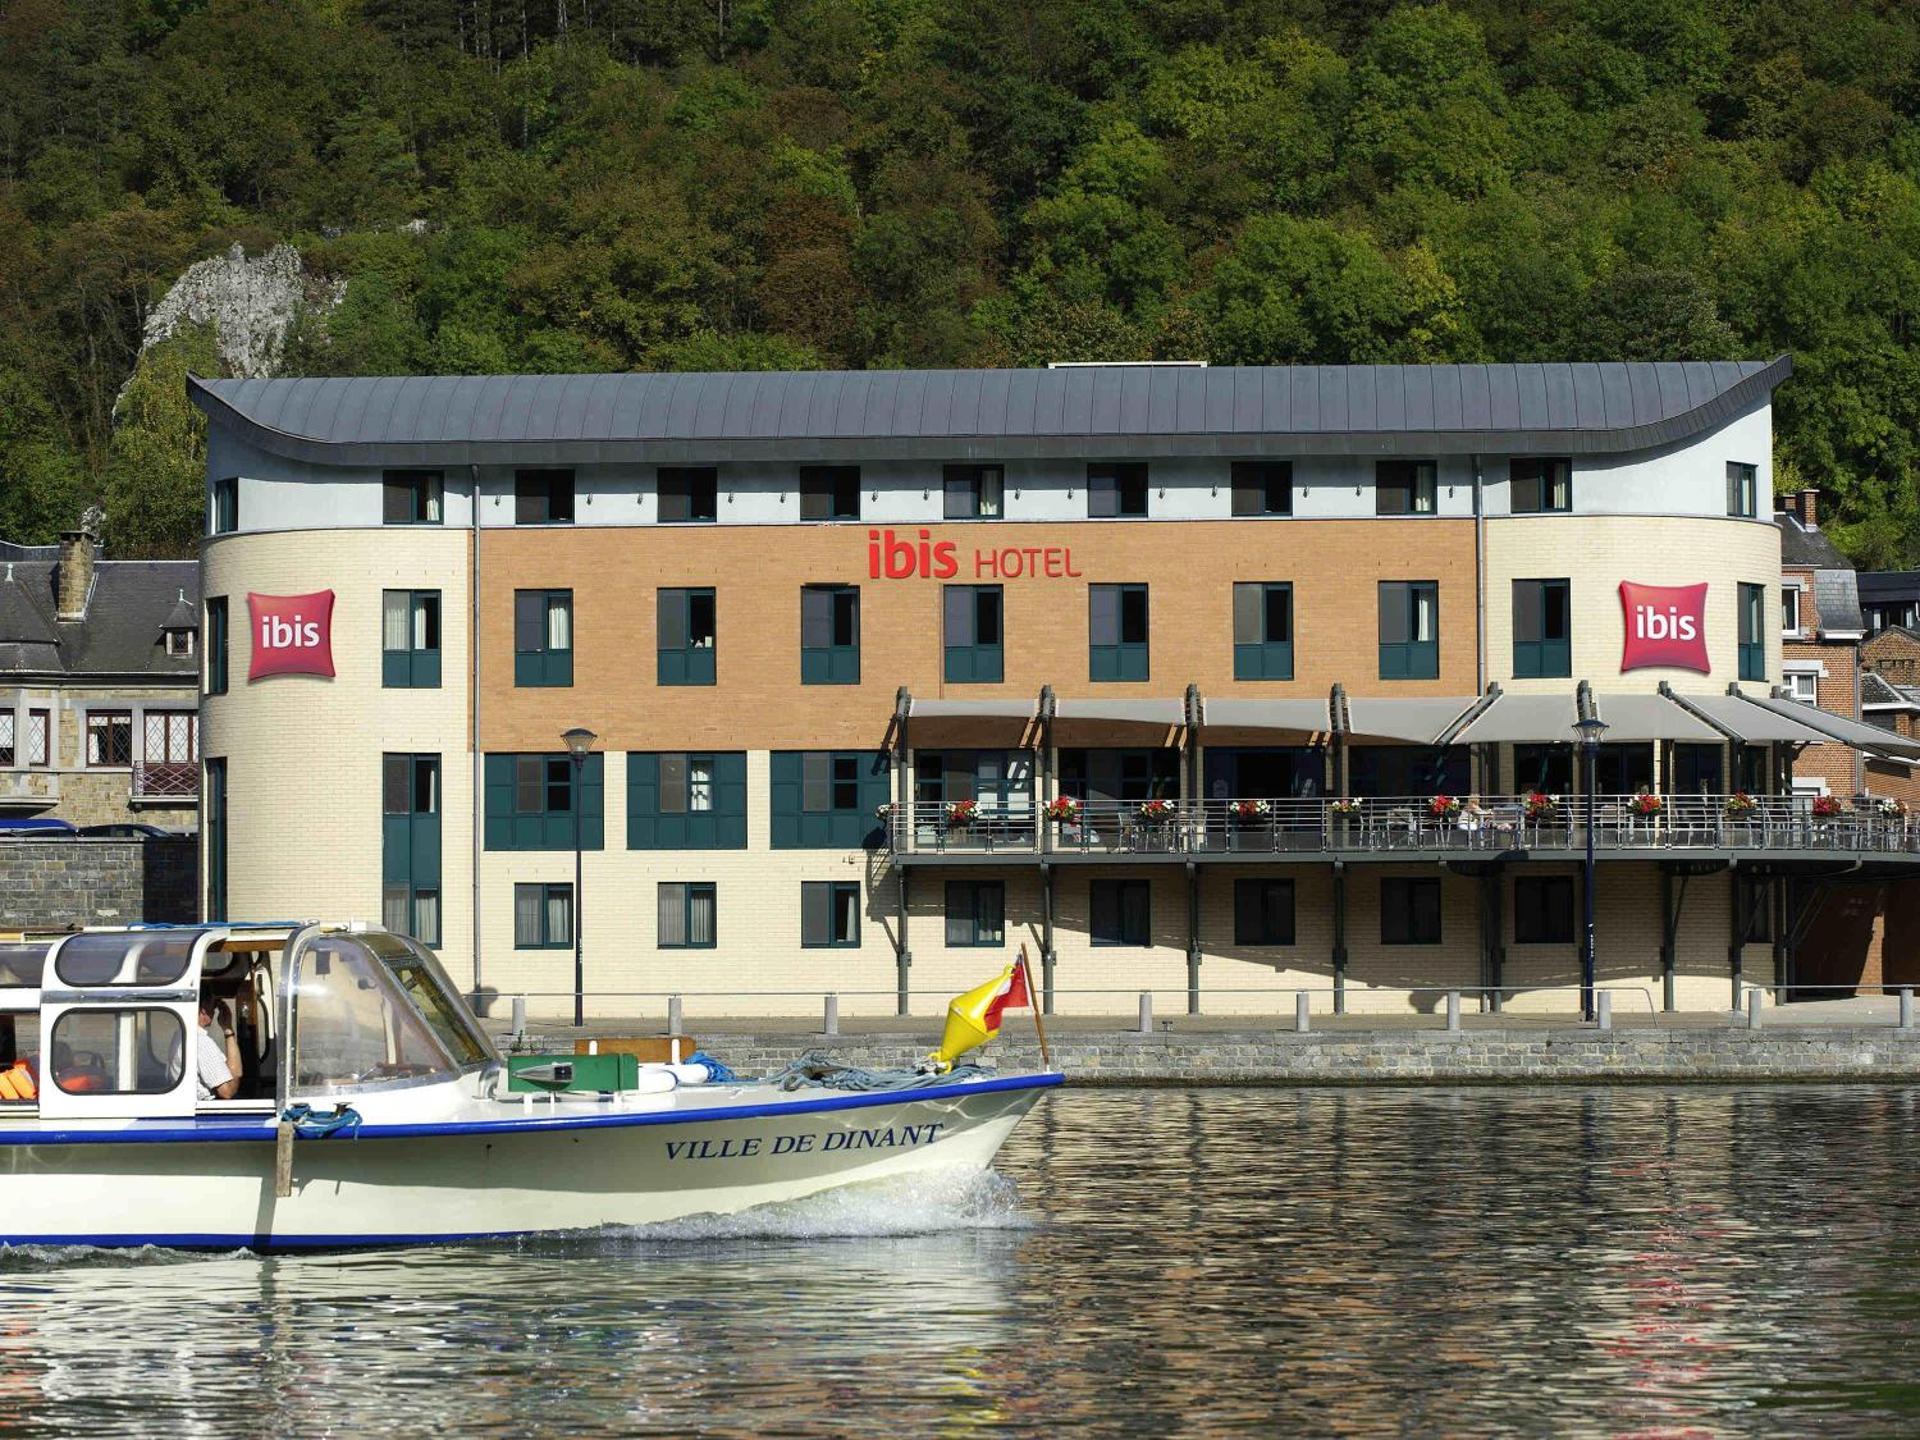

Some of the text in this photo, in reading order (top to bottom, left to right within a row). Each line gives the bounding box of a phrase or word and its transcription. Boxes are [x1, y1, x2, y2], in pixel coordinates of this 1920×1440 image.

[868, 529, 1083, 579] ibis HOTEL
[262, 614, 320, 648] ibis
[1636, 604, 1697, 640] ibis
[665, 1122, 944, 1160] VILLE DE DINANT
